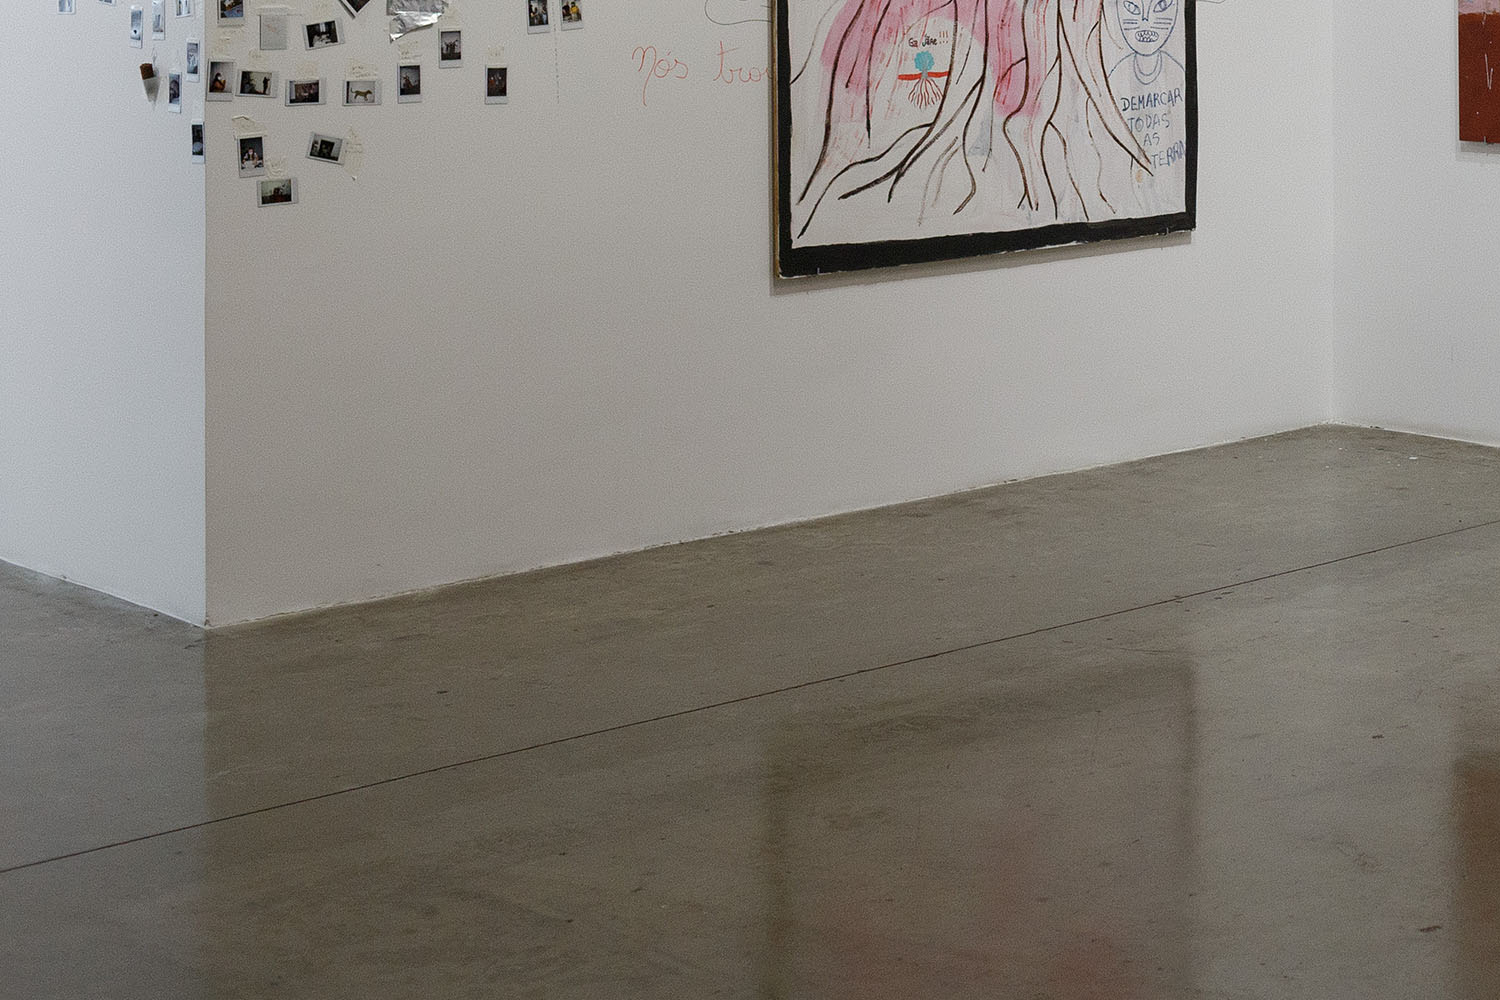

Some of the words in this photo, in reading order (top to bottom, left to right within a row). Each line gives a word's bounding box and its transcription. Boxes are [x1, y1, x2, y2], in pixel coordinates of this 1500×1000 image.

[1120, 87, 1183, 111] DEMARCAR
[1127, 113, 1170, 132] TODAS
[1143, 132, 1160, 146] AS
